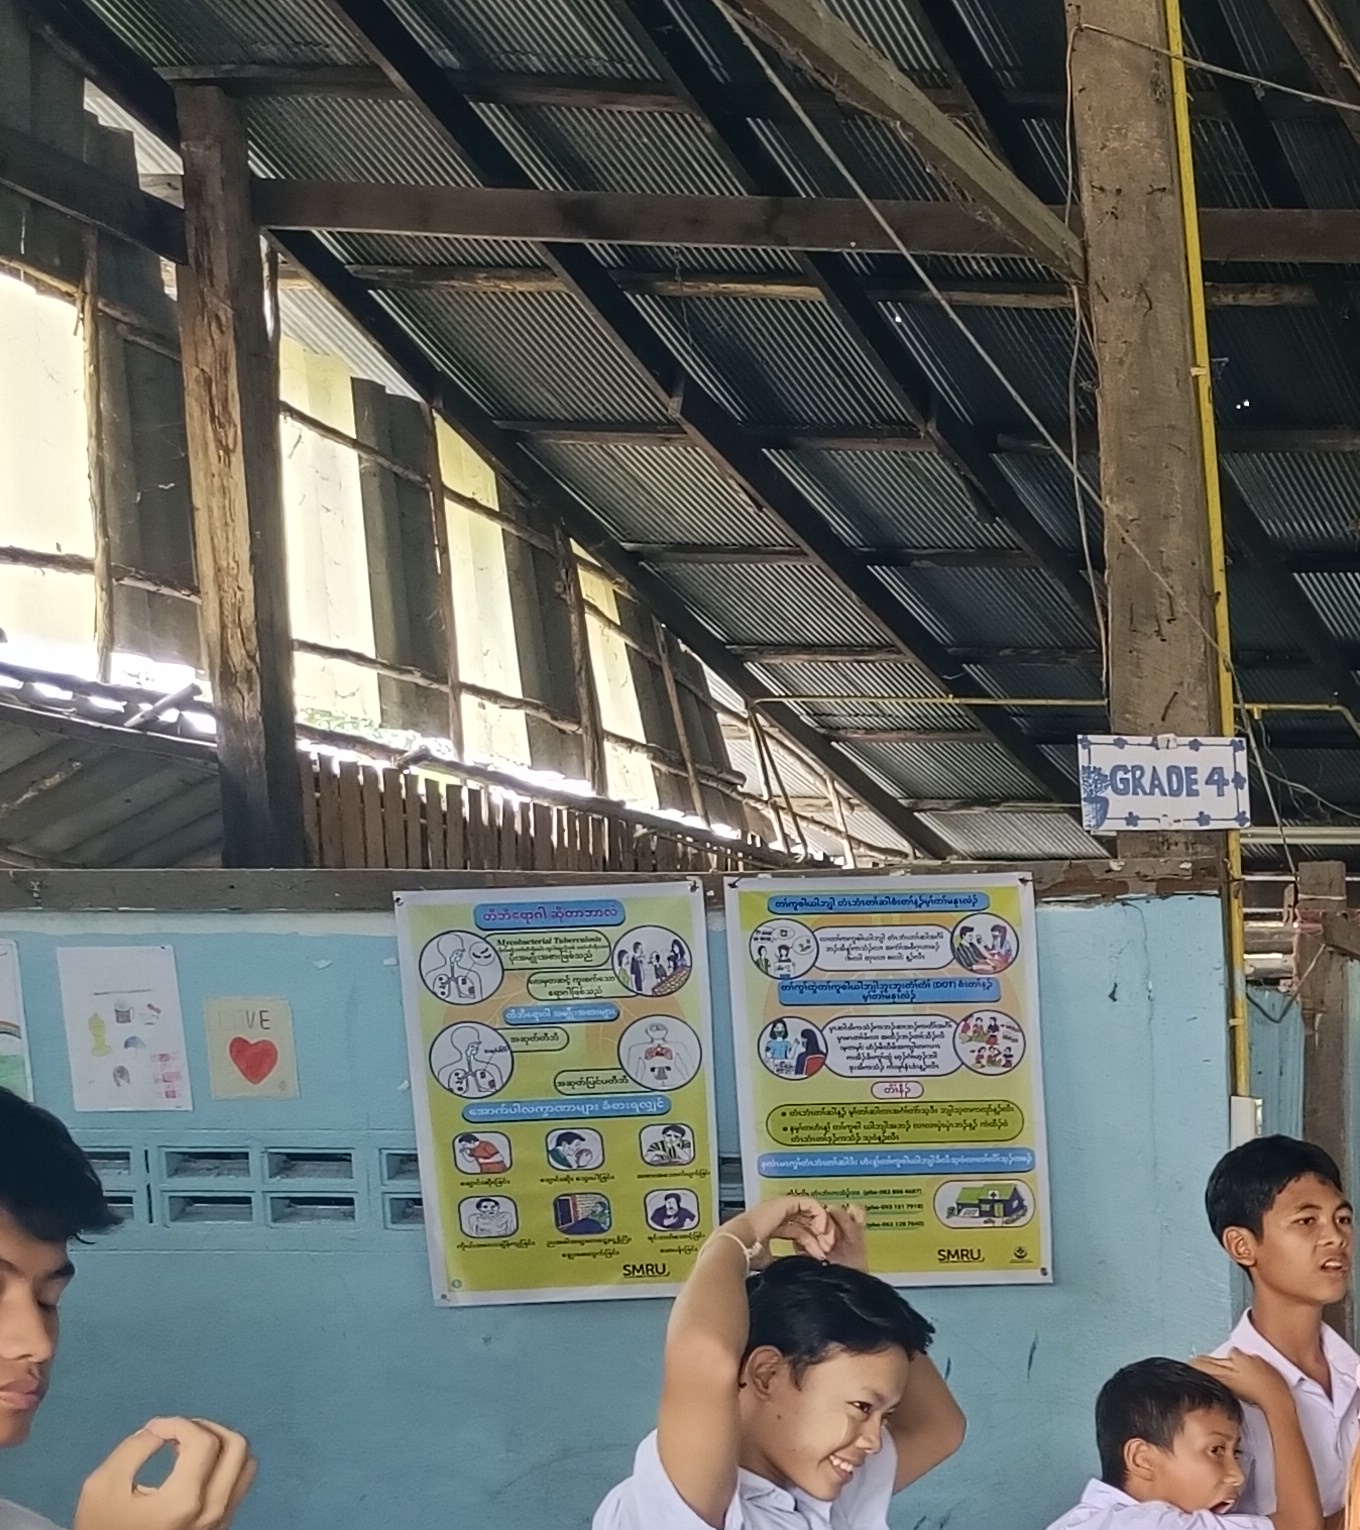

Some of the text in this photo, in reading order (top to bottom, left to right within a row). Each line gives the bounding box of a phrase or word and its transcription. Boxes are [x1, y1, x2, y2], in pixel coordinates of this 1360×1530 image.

[1109, 764, 1230, 798] GRADE 4
[933, 981, 957, 990] (DOT)
[938, 1248, 982, 1261] SMRU
[623, 1262, 667, 1277] SMRU
